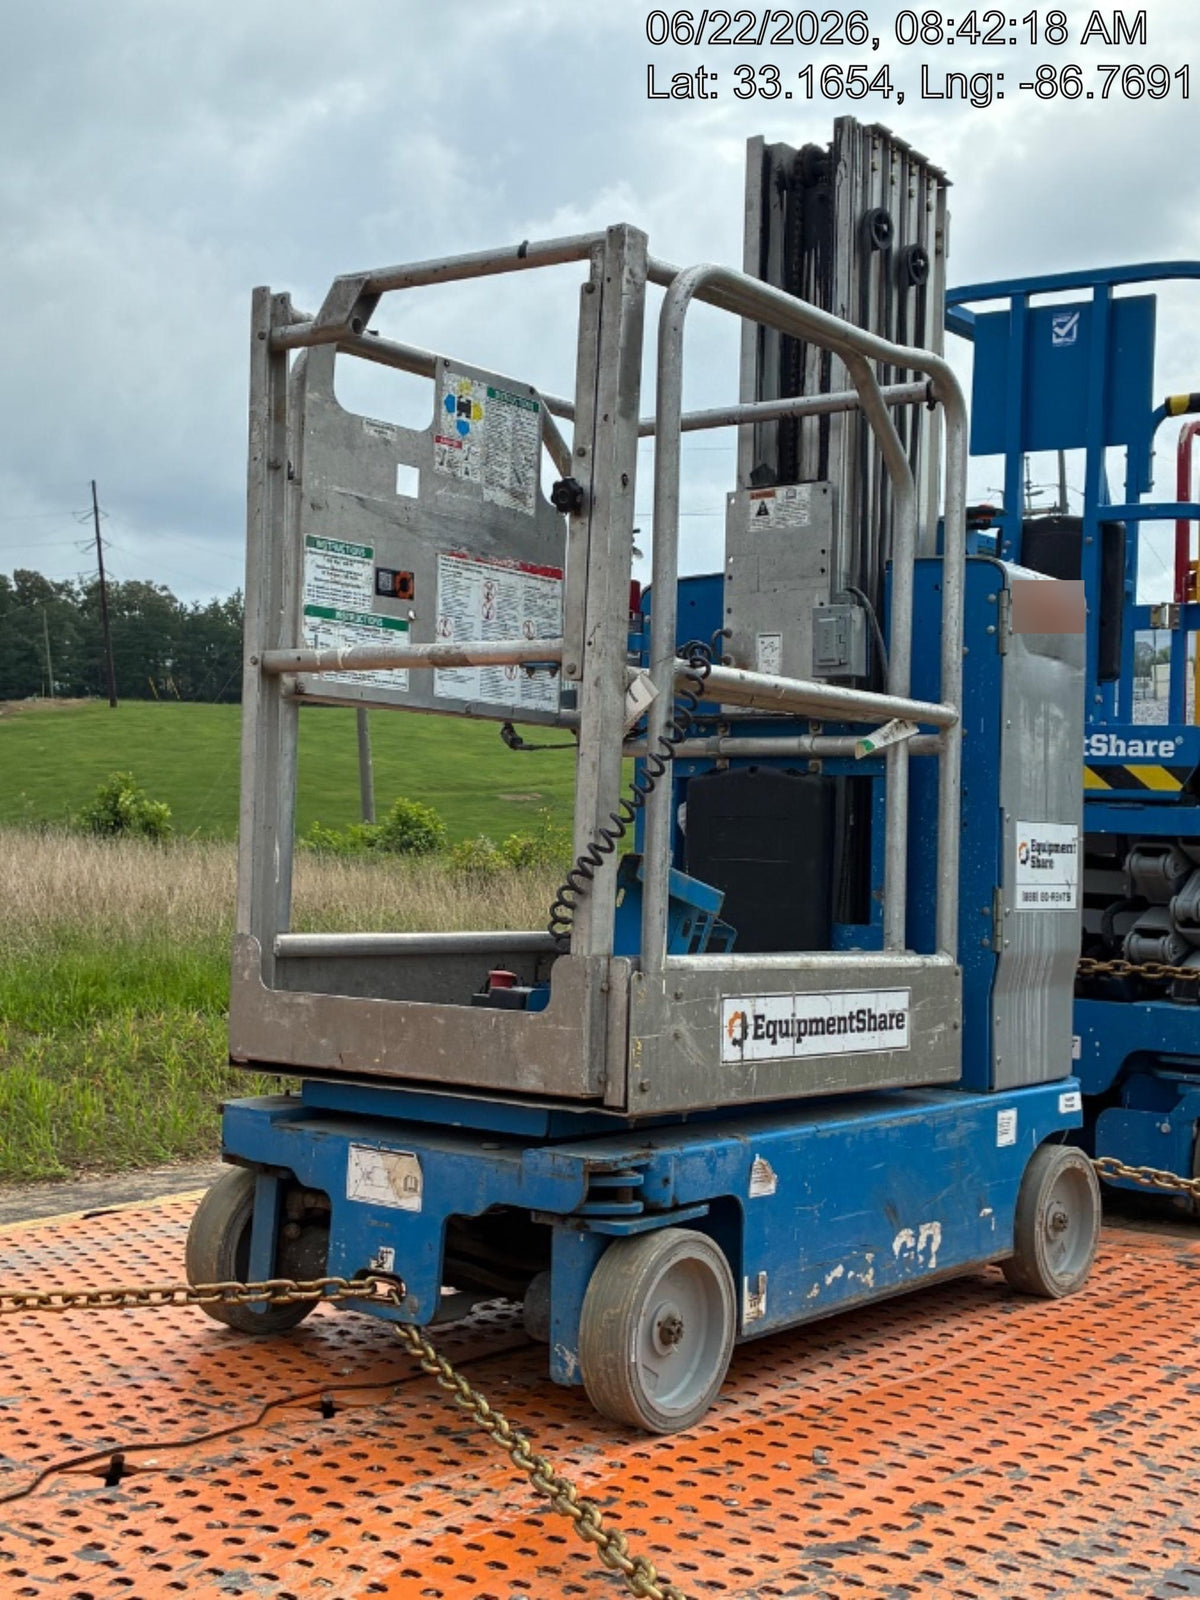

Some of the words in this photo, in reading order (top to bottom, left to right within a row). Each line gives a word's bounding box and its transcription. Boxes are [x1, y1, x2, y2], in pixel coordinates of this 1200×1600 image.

[1030, 839, 1077, 856] Equipment
[1030, 855, 1054, 870] Share
[752, 1007, 905, 1045] EquipmentShare
